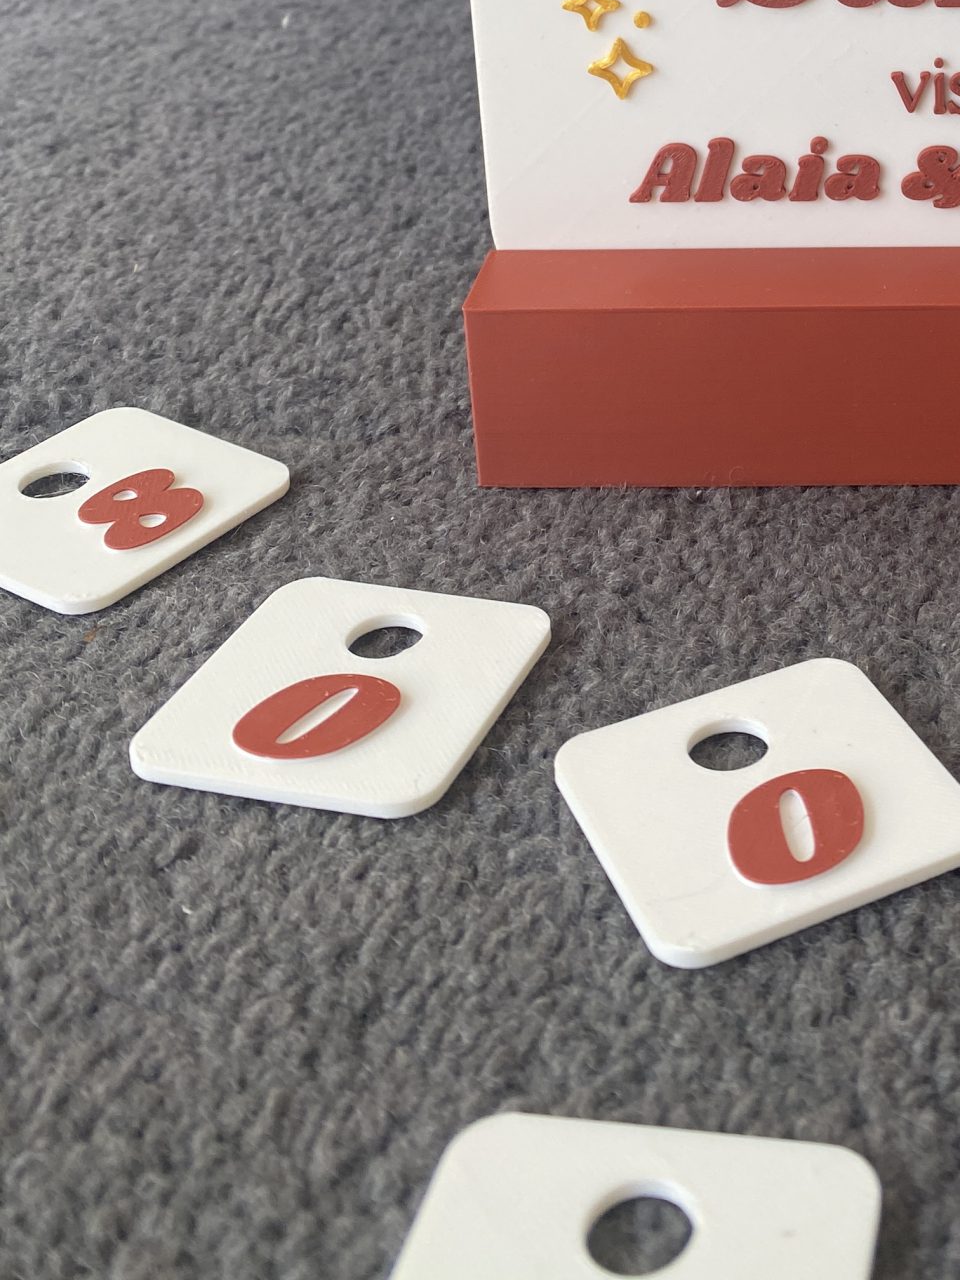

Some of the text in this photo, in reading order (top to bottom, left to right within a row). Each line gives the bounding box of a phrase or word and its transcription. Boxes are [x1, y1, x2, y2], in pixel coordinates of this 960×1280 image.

[628, 136, 882, 204] Alaia
[77, 467, 205, 551] 8
[231, 673, 402, 760] 0
[726, 768, 866, 886] 0
